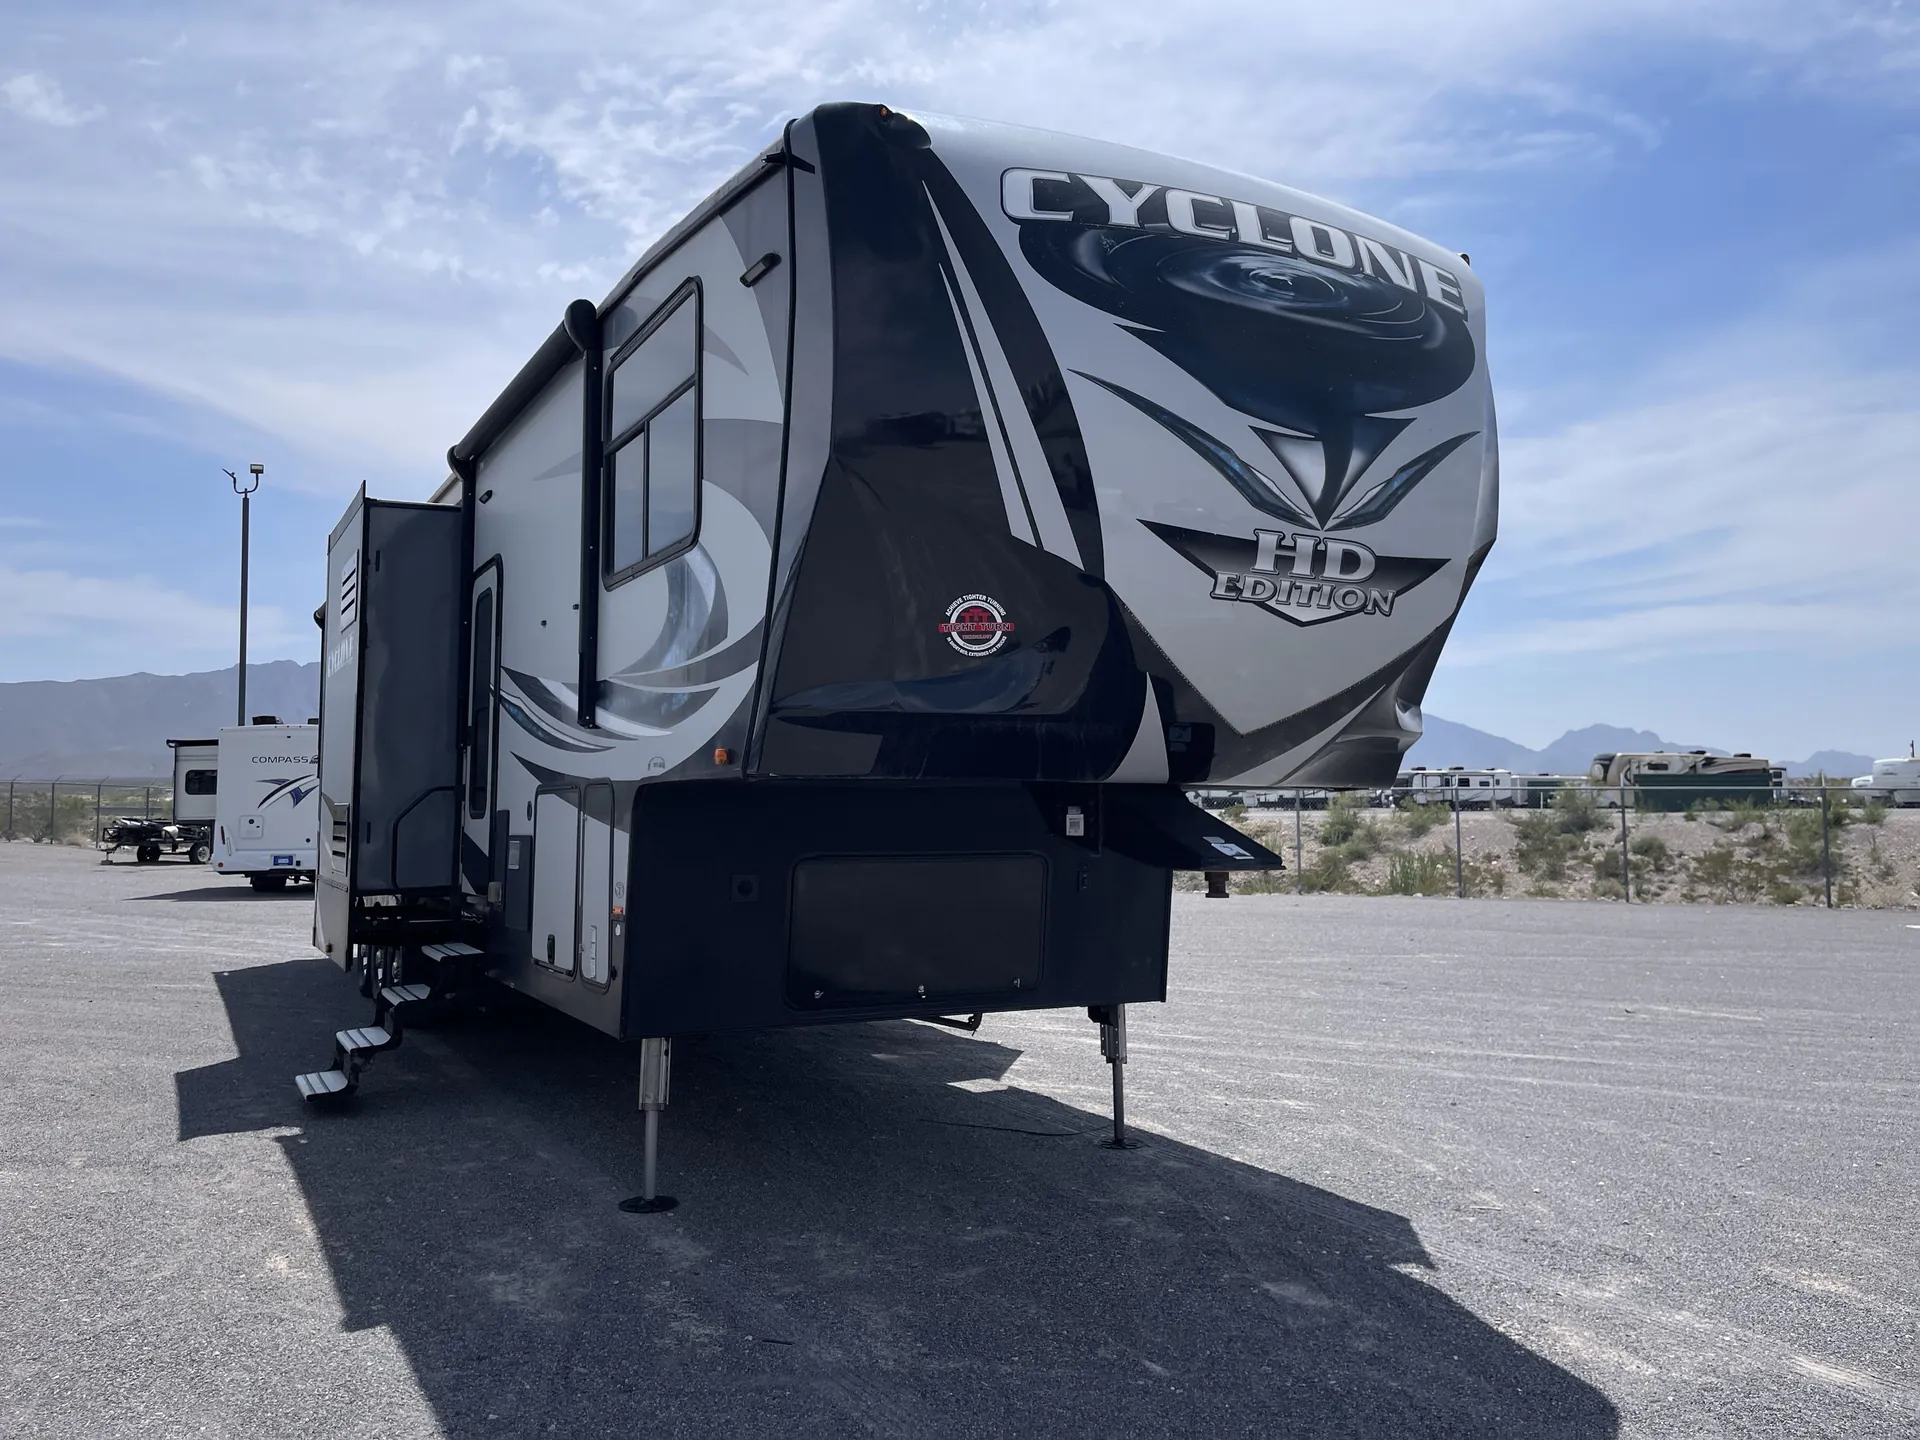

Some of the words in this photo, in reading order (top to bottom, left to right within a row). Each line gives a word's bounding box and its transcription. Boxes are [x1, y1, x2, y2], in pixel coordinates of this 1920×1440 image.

[1001, 167, 1468, 321] CYCLONE
[1251, 528, 1377, 583] HD
[945, 597, 964, 617] ACHIEVE
[963, 593, 987, 602] TIGHTER
[987, 596, 1007, 616] TURNING
[1210, 571, 1396, 617] EDITION
[942, 622, 977, 632] TIGHT
[979, 622, 1011, 632] TURN
[251, 756, 309, 764] COMPASS
